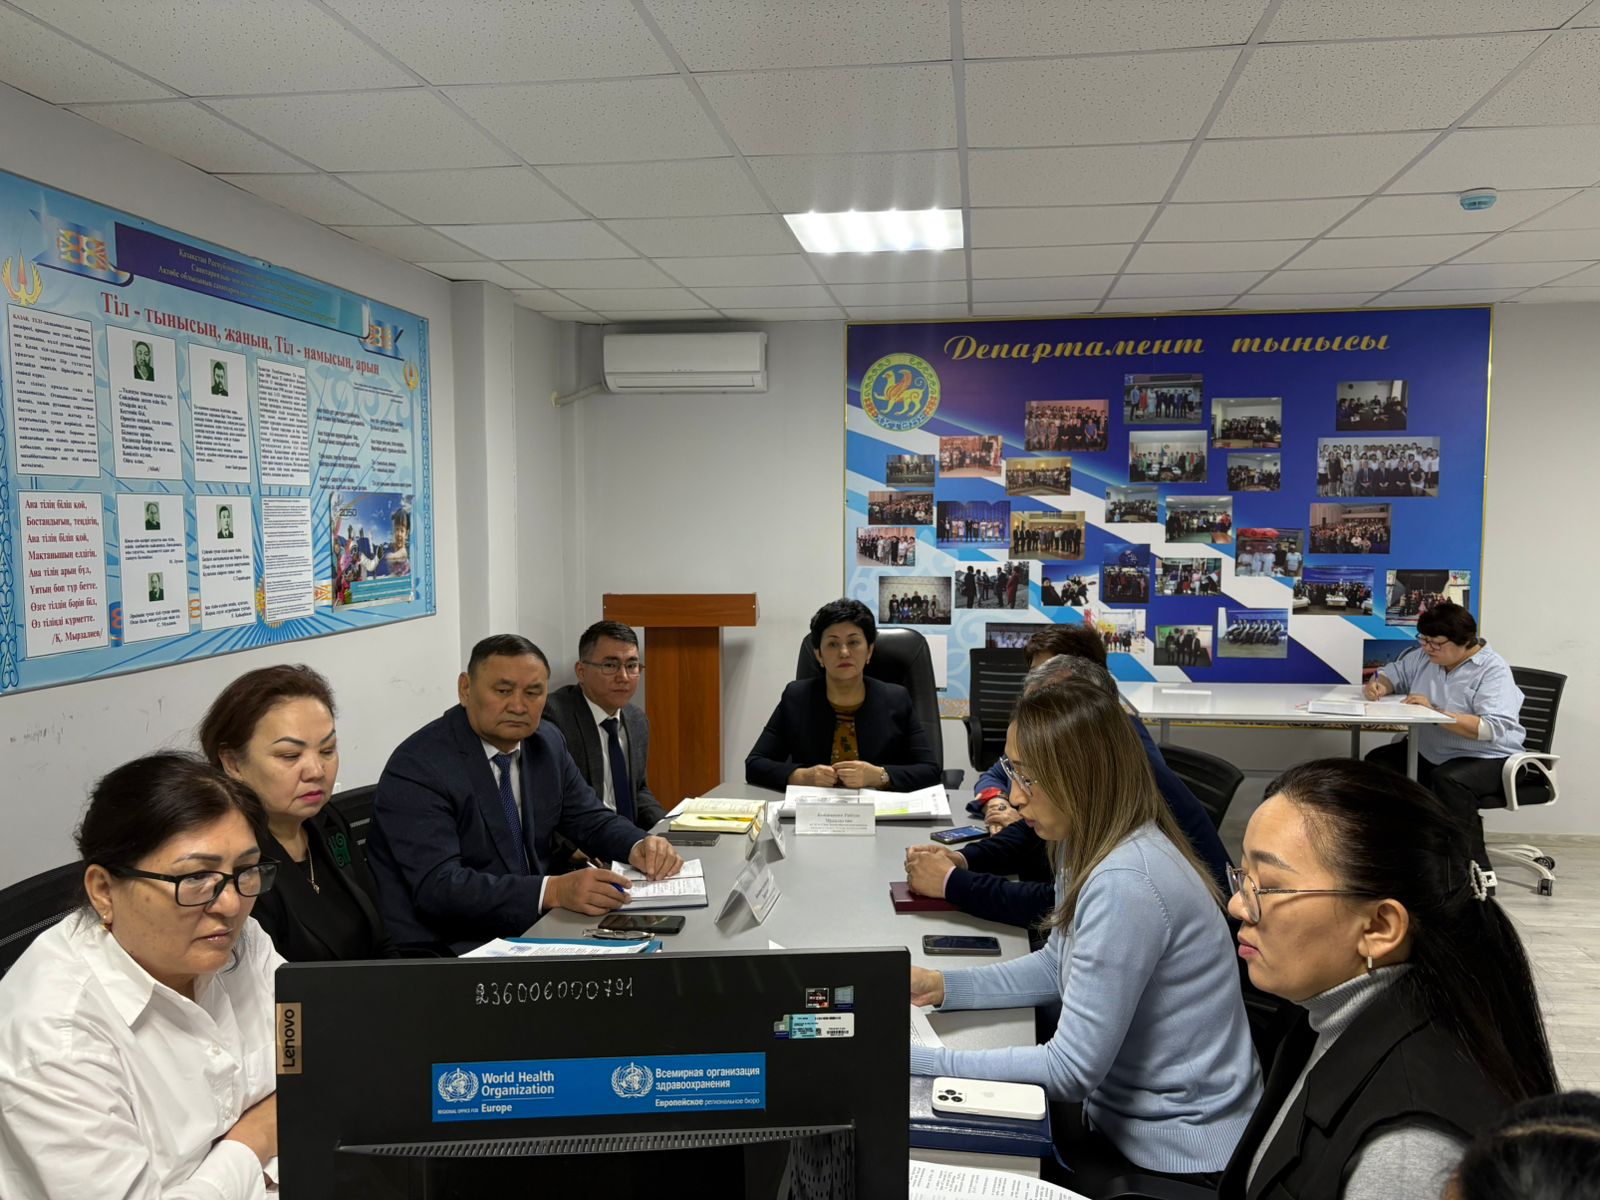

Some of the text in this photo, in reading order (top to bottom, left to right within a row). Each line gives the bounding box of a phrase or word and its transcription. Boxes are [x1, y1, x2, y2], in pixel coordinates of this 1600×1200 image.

[101, 291, 129, 318] Тіл
[274, 335, 294, 356] Тіл
[943, 334, 1391, 365] Департамент тынысы
[25, 499, 38, 509] Ана
[339, 508, 358, 517] 2050
[27, 533, 40, 543] Ана
[29, 568, 42, 578] Ана
[282, 1008, 296, 1068] Lenovo
[481, 1070, 555, 1085] World Health
[655, 1066, 760, 1081] Всемирная организация
[481, 1083, 555, 1099] Organization
[655, 1079, 731, 1092] здравоохранения
[481, 1103, 513, 1115] Europe
[655, 1097, 704, 1108] Европейское
[744, 1097, 760, 1105] бюро
